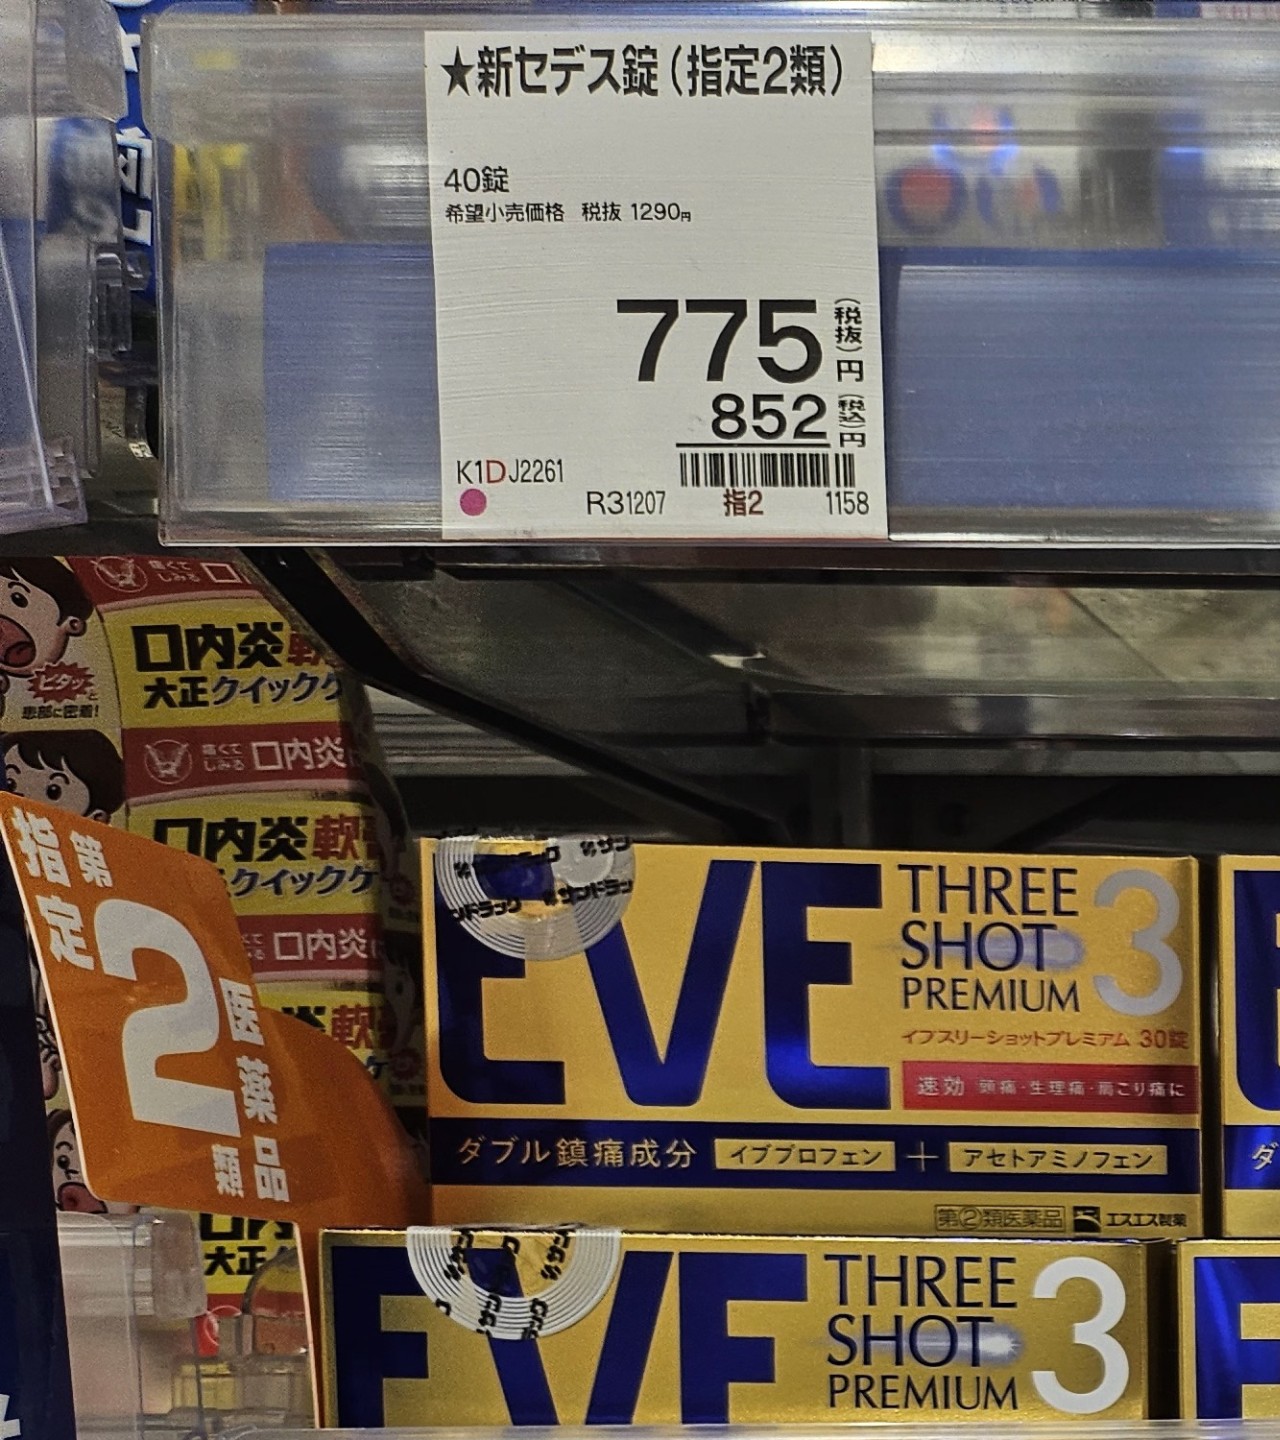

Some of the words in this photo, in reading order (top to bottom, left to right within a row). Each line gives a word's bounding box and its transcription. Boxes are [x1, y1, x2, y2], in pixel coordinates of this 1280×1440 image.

[444, 166, 509, 193] 40錠
[445, 203, 565, 223] 希望小売価格
[582, 203, 621, 223] 税抜
[631, 204, 691, 222] 1290円
[616, 299, 822, 383] 775
[712, 395, 827, 440] 852
[723, 490, 764, 517] 指2
[825, 491, 869, 515] 1158
[898, 864, 1079, 917] THREE
[902, 920, 1060, 973] SHOT
[1093, 870, 1184, 1017] 3
[433, 860, 890, 1110] EVE
[902, 977, 1081, 1013] PREMIUM
[93, 898, 242, 1137] 2
[1139, 1028, 1188, 1051] 30錠
[218, 977, 290, 1202] 医薬品
[916, 1076, 964, 1098] 速効
[458, 1137, 698, 1169] ダブル鎮痛成分
[728, 1145, 882, 1168] イブプロフェン
[962, 1147, 1154, 1169] アセトアミノフェン
